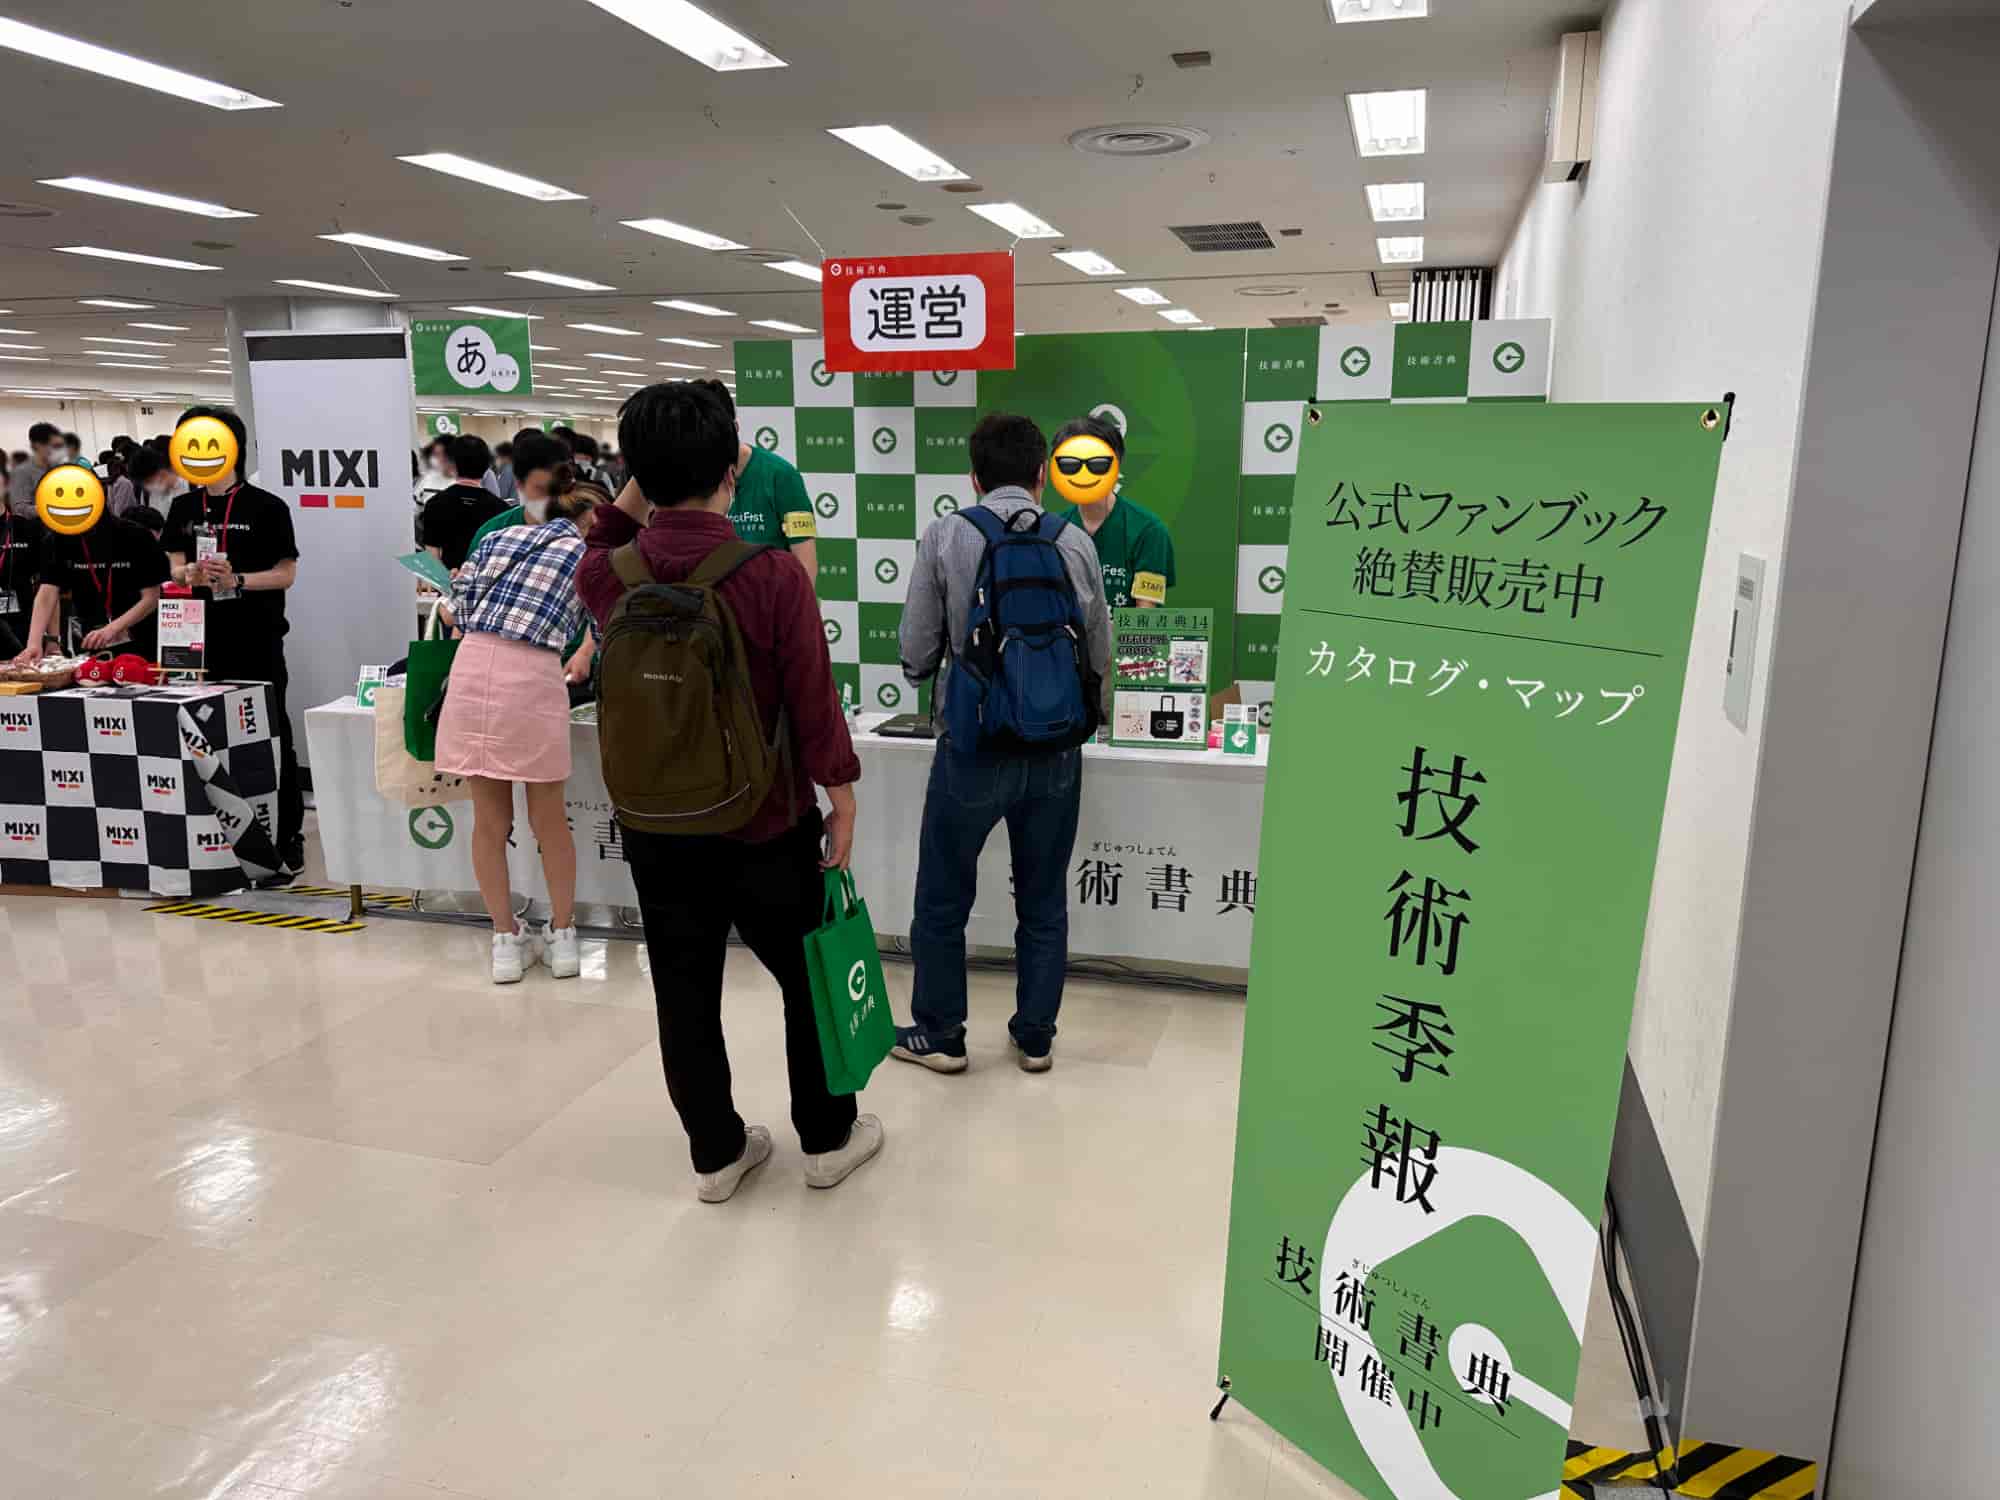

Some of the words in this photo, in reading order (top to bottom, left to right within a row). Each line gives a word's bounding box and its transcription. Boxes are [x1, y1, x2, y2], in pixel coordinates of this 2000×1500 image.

[867, 284, 966, 340] 運営
[457, 337, 486, 376] あ
[281, 449, 378, 488] MIXI
[1326, 481, 1668, 549] 公式ファンブック
[1352, 545, 1605, 619] 絶賛販売中
[1306, 641, 1645, 726] カタログ・マップ
[0, 713, 33, 726] MIXI
[94, 717, 127, 730] MIXI
[244, 697, 257, 734] MIXI
[51, 770, 84, 783] MIXI
[147, 775, 176, 789] MIXI
[5, 823, 40, 835] MIXI
[107, 826, 139, 840] MIXI
[1092, 841, 1177, 857] ぎじゅつしょてん
[1360, 746, 1487, 1215] 技術季報
[1274, 1235, 1513, 1417] 技術書典
[1314, 1324, 1443, 1431] 開催中
